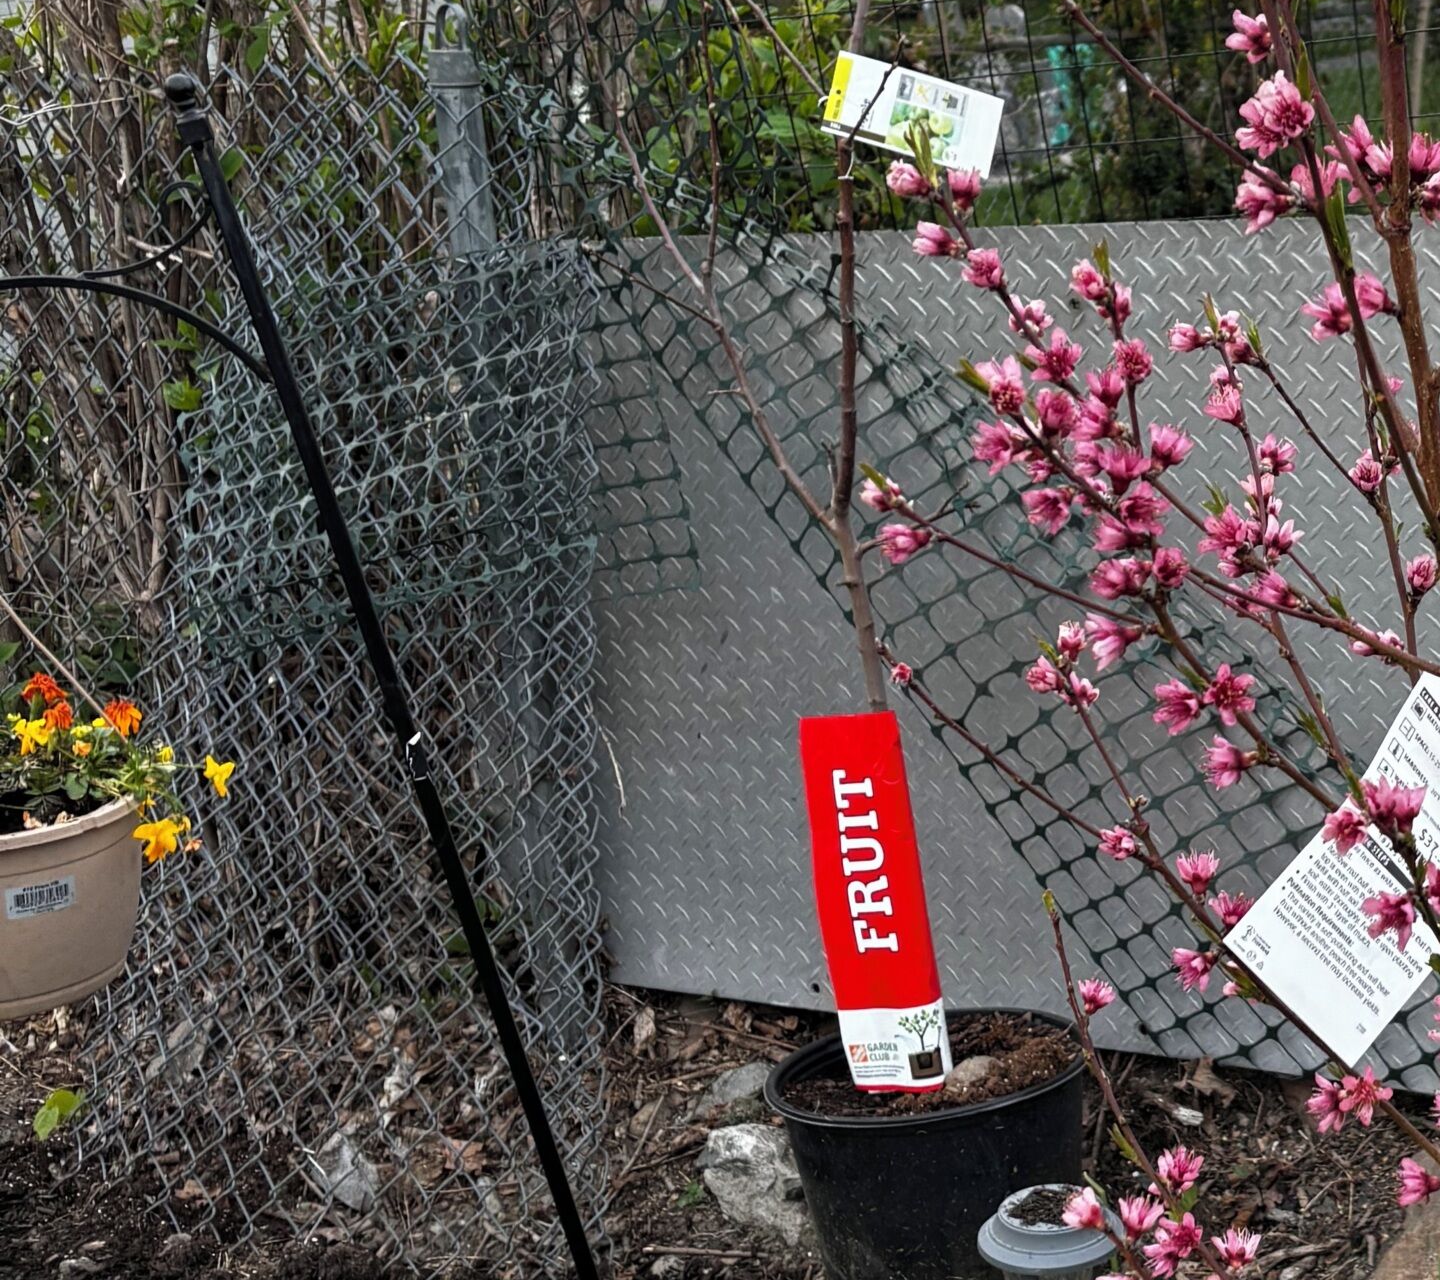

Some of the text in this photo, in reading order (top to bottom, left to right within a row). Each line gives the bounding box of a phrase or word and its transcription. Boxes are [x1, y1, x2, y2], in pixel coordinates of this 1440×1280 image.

[1420, 688, 1434, 708] CARE
[1432, 704, 1439, 715] &
[1413, 731, 1430, 755] SPACE:
[1403, 752, 1429, 787] HARDINESS
[832, 769, 900, 954] FRUIT
[1369, 844, 1392, 866] STEPS
[1325, 872, 1340, 887] with
[1315, 889, 1330, 905] with
[1285, 876, 1356, 947] Pollination Requirements:
[1286, 891, 1300, 905] This
[1296, 902, 1317, 923] variety
[1355, 961, 1370, 975] and
[1289, 909, 1312, 932] without
[1309, 929, 1331, 951] another
[1327, 948, 1348, 968] peach
[1344, 964, 1358, 978] tree
[1299, 933, 1321, 955] second
[1318, 952, 1332, 966] tree
[1327, 963, 1343, 979] may
[866, 1041, 898, 1052] GARDEN
[869, 1052, 890, 1062] CLUB
